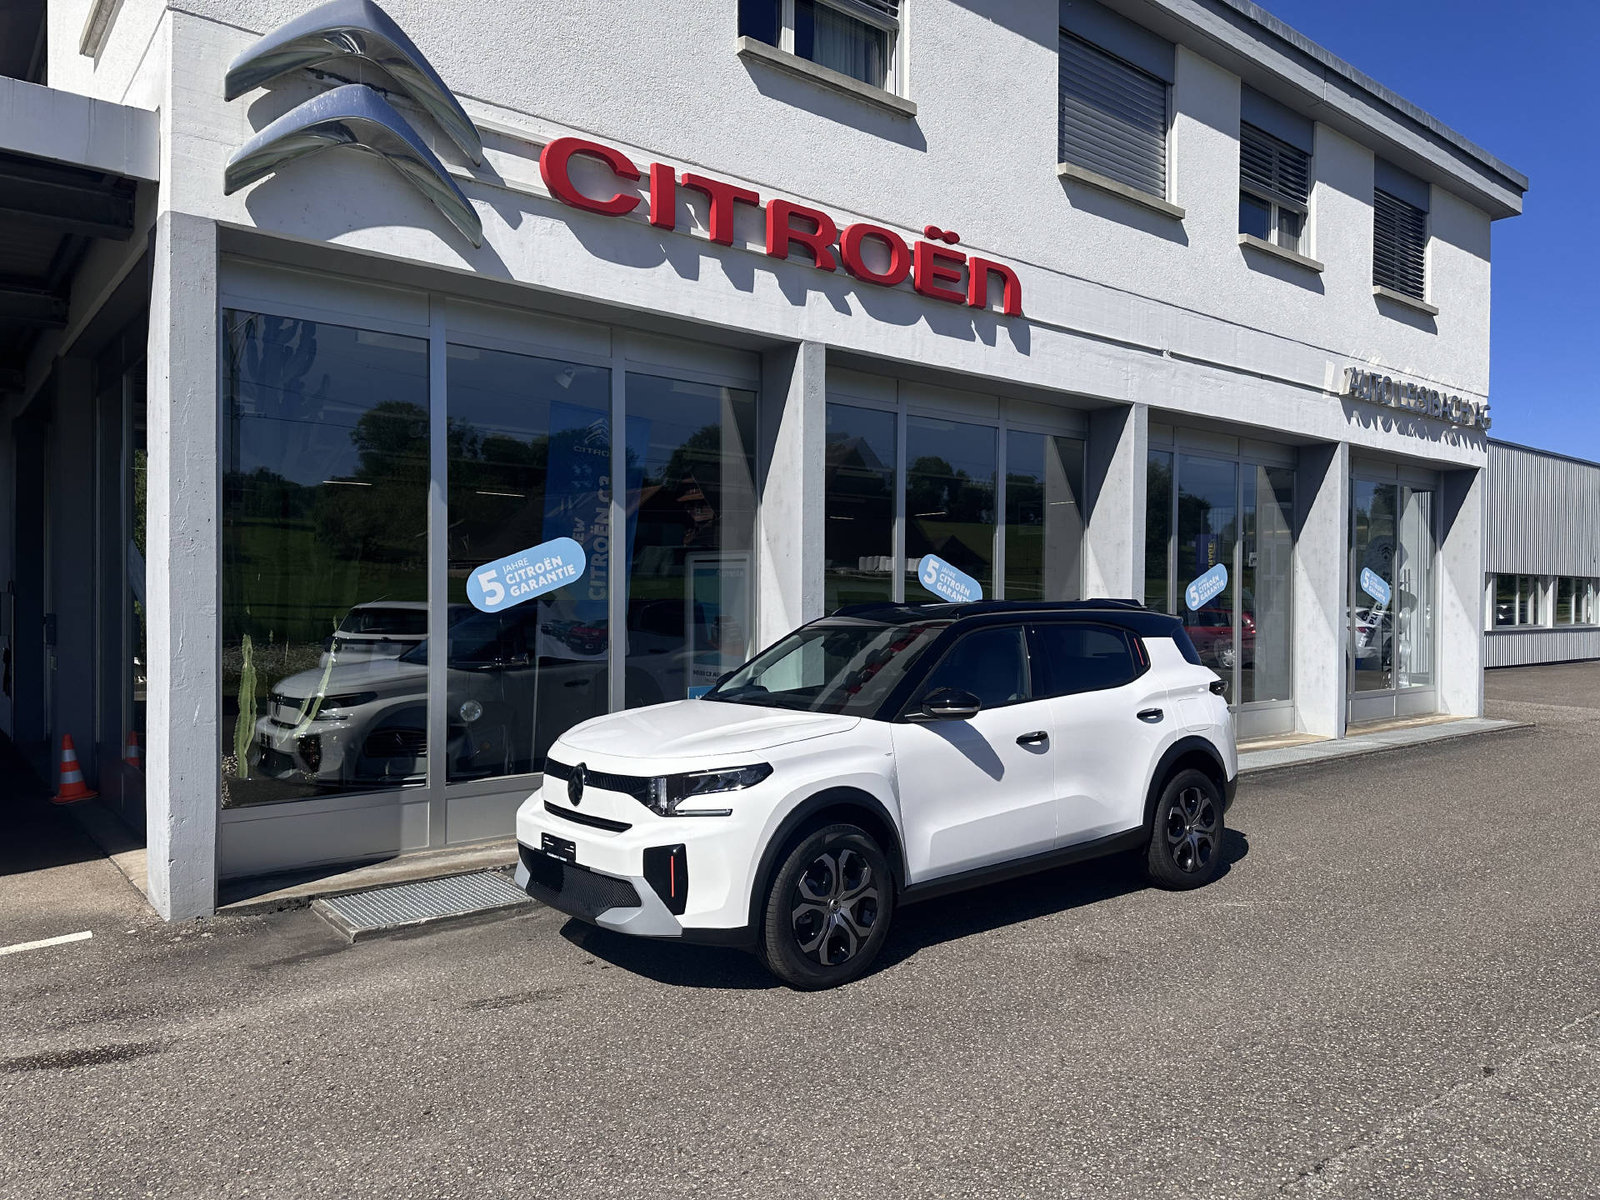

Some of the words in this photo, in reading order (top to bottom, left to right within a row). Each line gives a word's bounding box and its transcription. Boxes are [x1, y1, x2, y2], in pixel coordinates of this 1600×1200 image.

[539, 136, 1022, 317] CITROËN
[1345, 367, 1393, 405] AUTO
[573, 445, 609, 458] CITRO
[572, 517, 585, 545] EW
[503, 557, 530, 574] JAHRE
[505, 555, 563, 584] CITROËN
[923, 558, 940, 584] 5
[478, 569, 505, 606] 5
[510, 564, 576, 597] GARANTIE
[936, 582, 972, 602] GARAN
[940, 573, 971, 597] CITROËN
[1362, 570, 1371, 588] 5
[1189, 585, 1200, 607] 5
